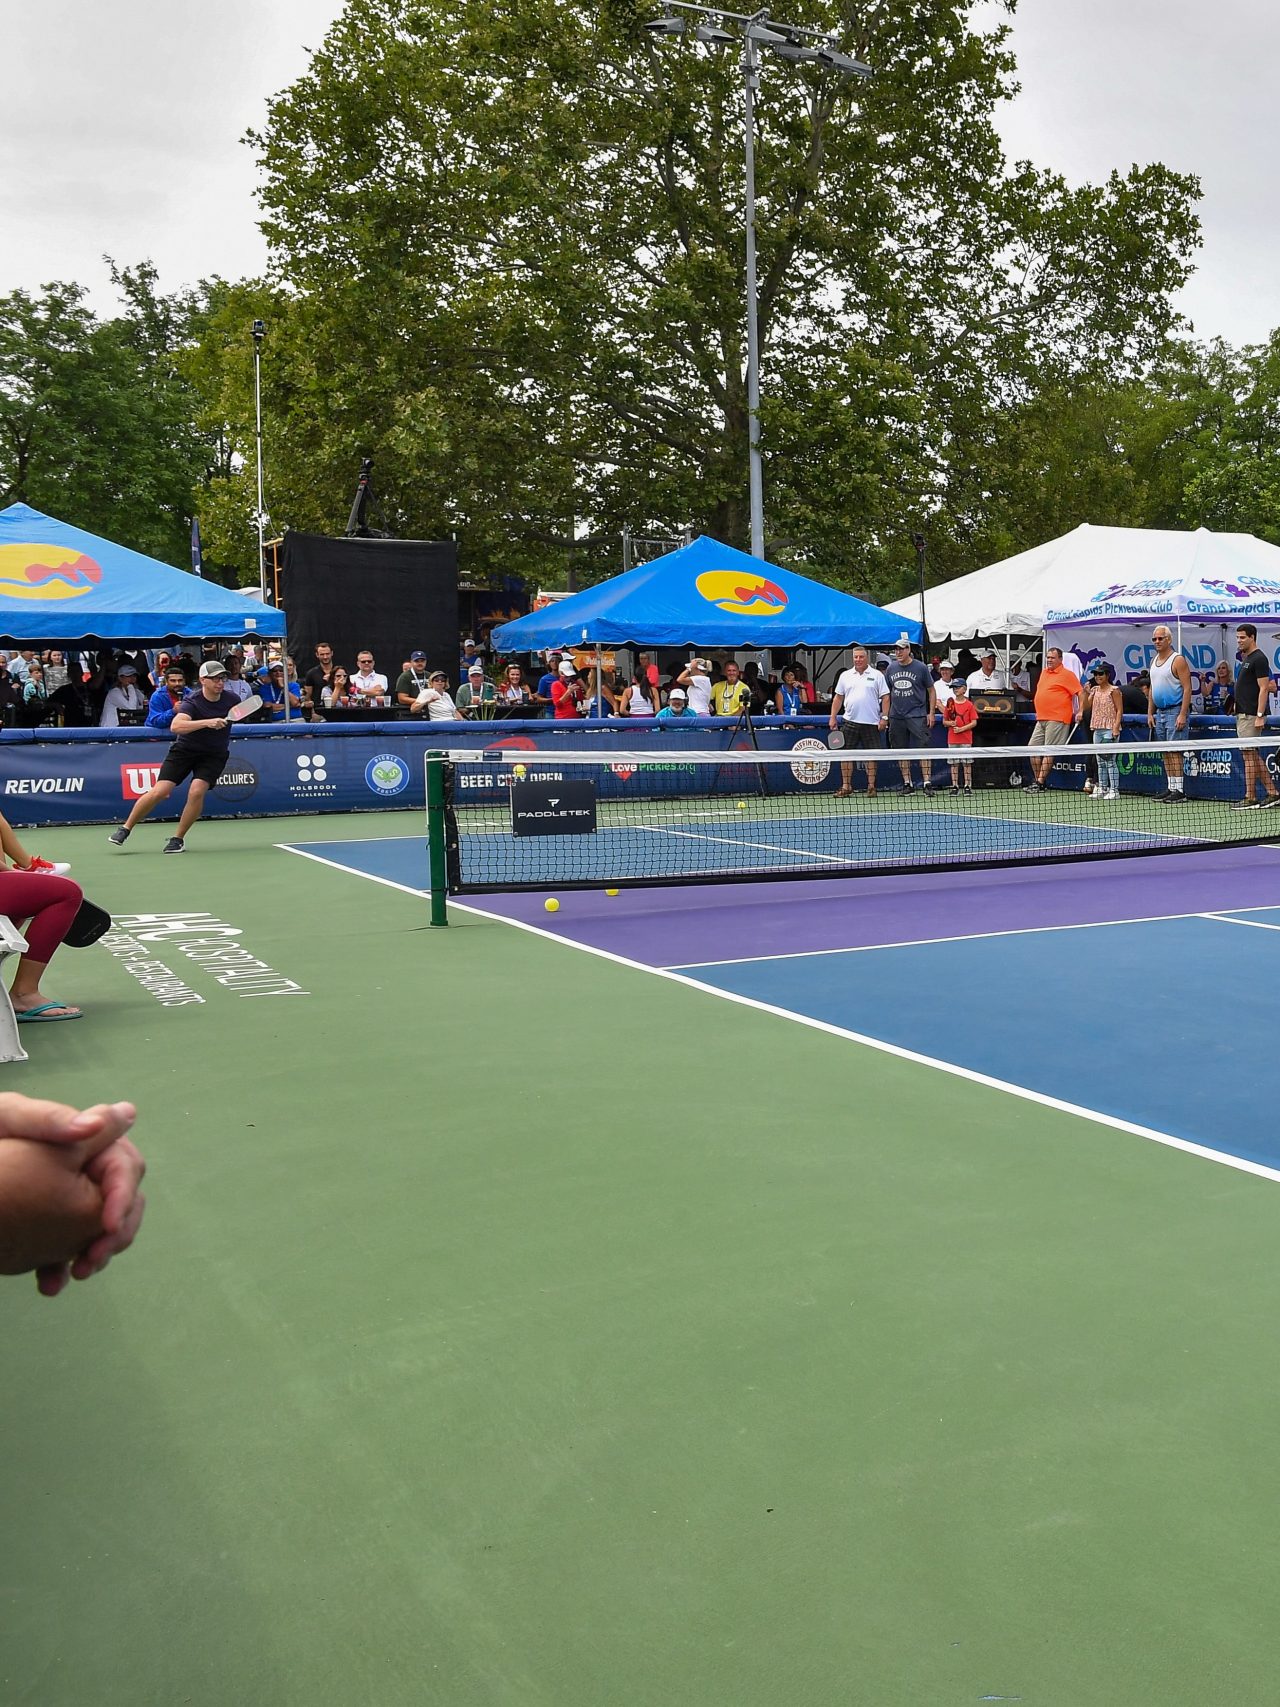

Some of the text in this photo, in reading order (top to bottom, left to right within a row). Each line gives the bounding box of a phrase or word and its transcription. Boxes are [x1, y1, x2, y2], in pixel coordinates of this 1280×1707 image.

[1104, 602, 1148, 614] Pickleball
[1150, 599, 1173, 613] Club
[1186, 600, 1226, 614] Grand
[1229, 602, 1271, 616] Rapids
[611, 761, 638, 773] Love
[1200, 762, 1232, 775] RAPIDS
[5, 777, 85, 795] REVOLIN
[460, 774, 494, 788] BEER
[517, 809, 591, 819] PADDLETEK
[169, 936, 311, 998] HOSPITALITY
